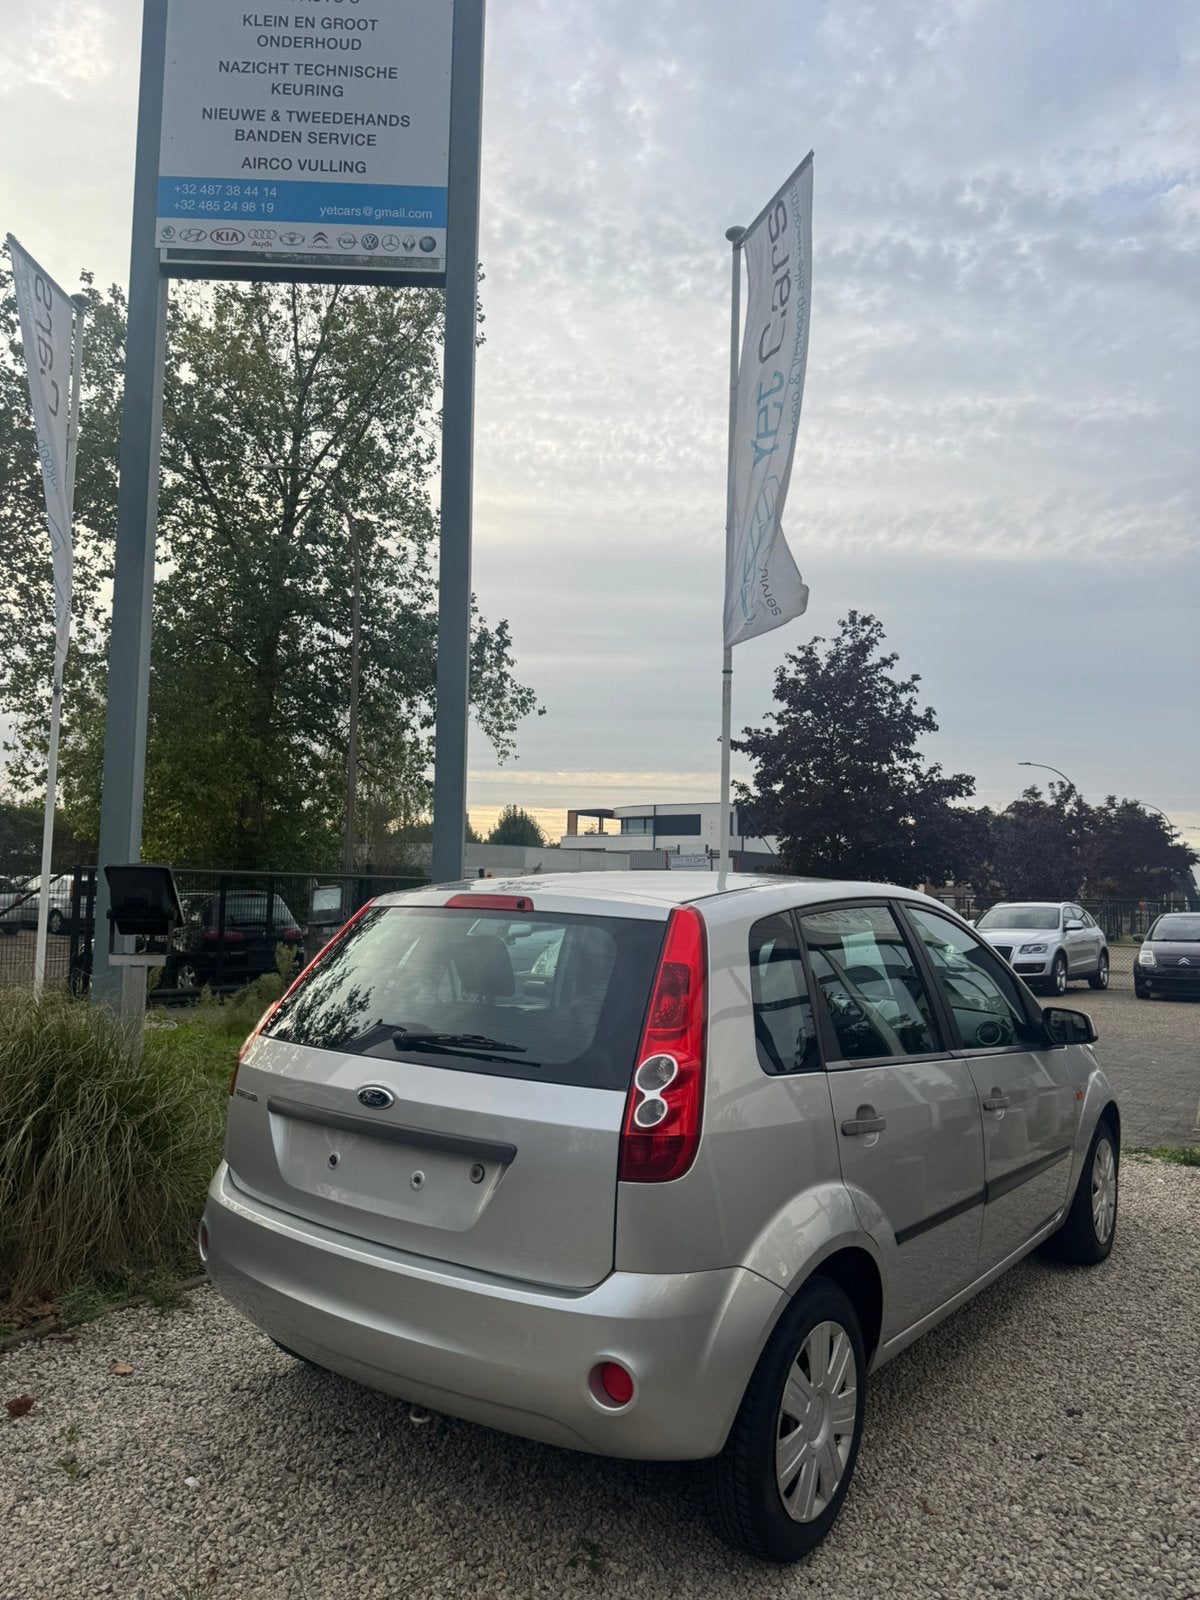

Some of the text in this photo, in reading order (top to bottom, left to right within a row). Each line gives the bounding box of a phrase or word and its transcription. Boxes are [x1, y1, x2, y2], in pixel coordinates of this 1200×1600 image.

[242, 14, 379, 31] KLEIN EN GROOT
[256, 34, 362, 51] ONDERHOUD
[218, 60, 398, 79] NAZICHT TECHNISCHE
[271, 82, 344, 98] KEURING
[202, 107, 411, 128] NIEUWE & TWEEDEHANDS
[234, 129, 377, 146] BANDEN SERVICE
[241, 156, 367, 174] AIRCO VULLING
[173, 184, 277, 198] +32 487 38 44 14
[173, 199, 275, 213] +32 485 24 98 19
[319, 205, 433, 219] yetcars@gmail.com
[215, 231, 239, 242] KIA
[758, 199, 791, 364] Cars
